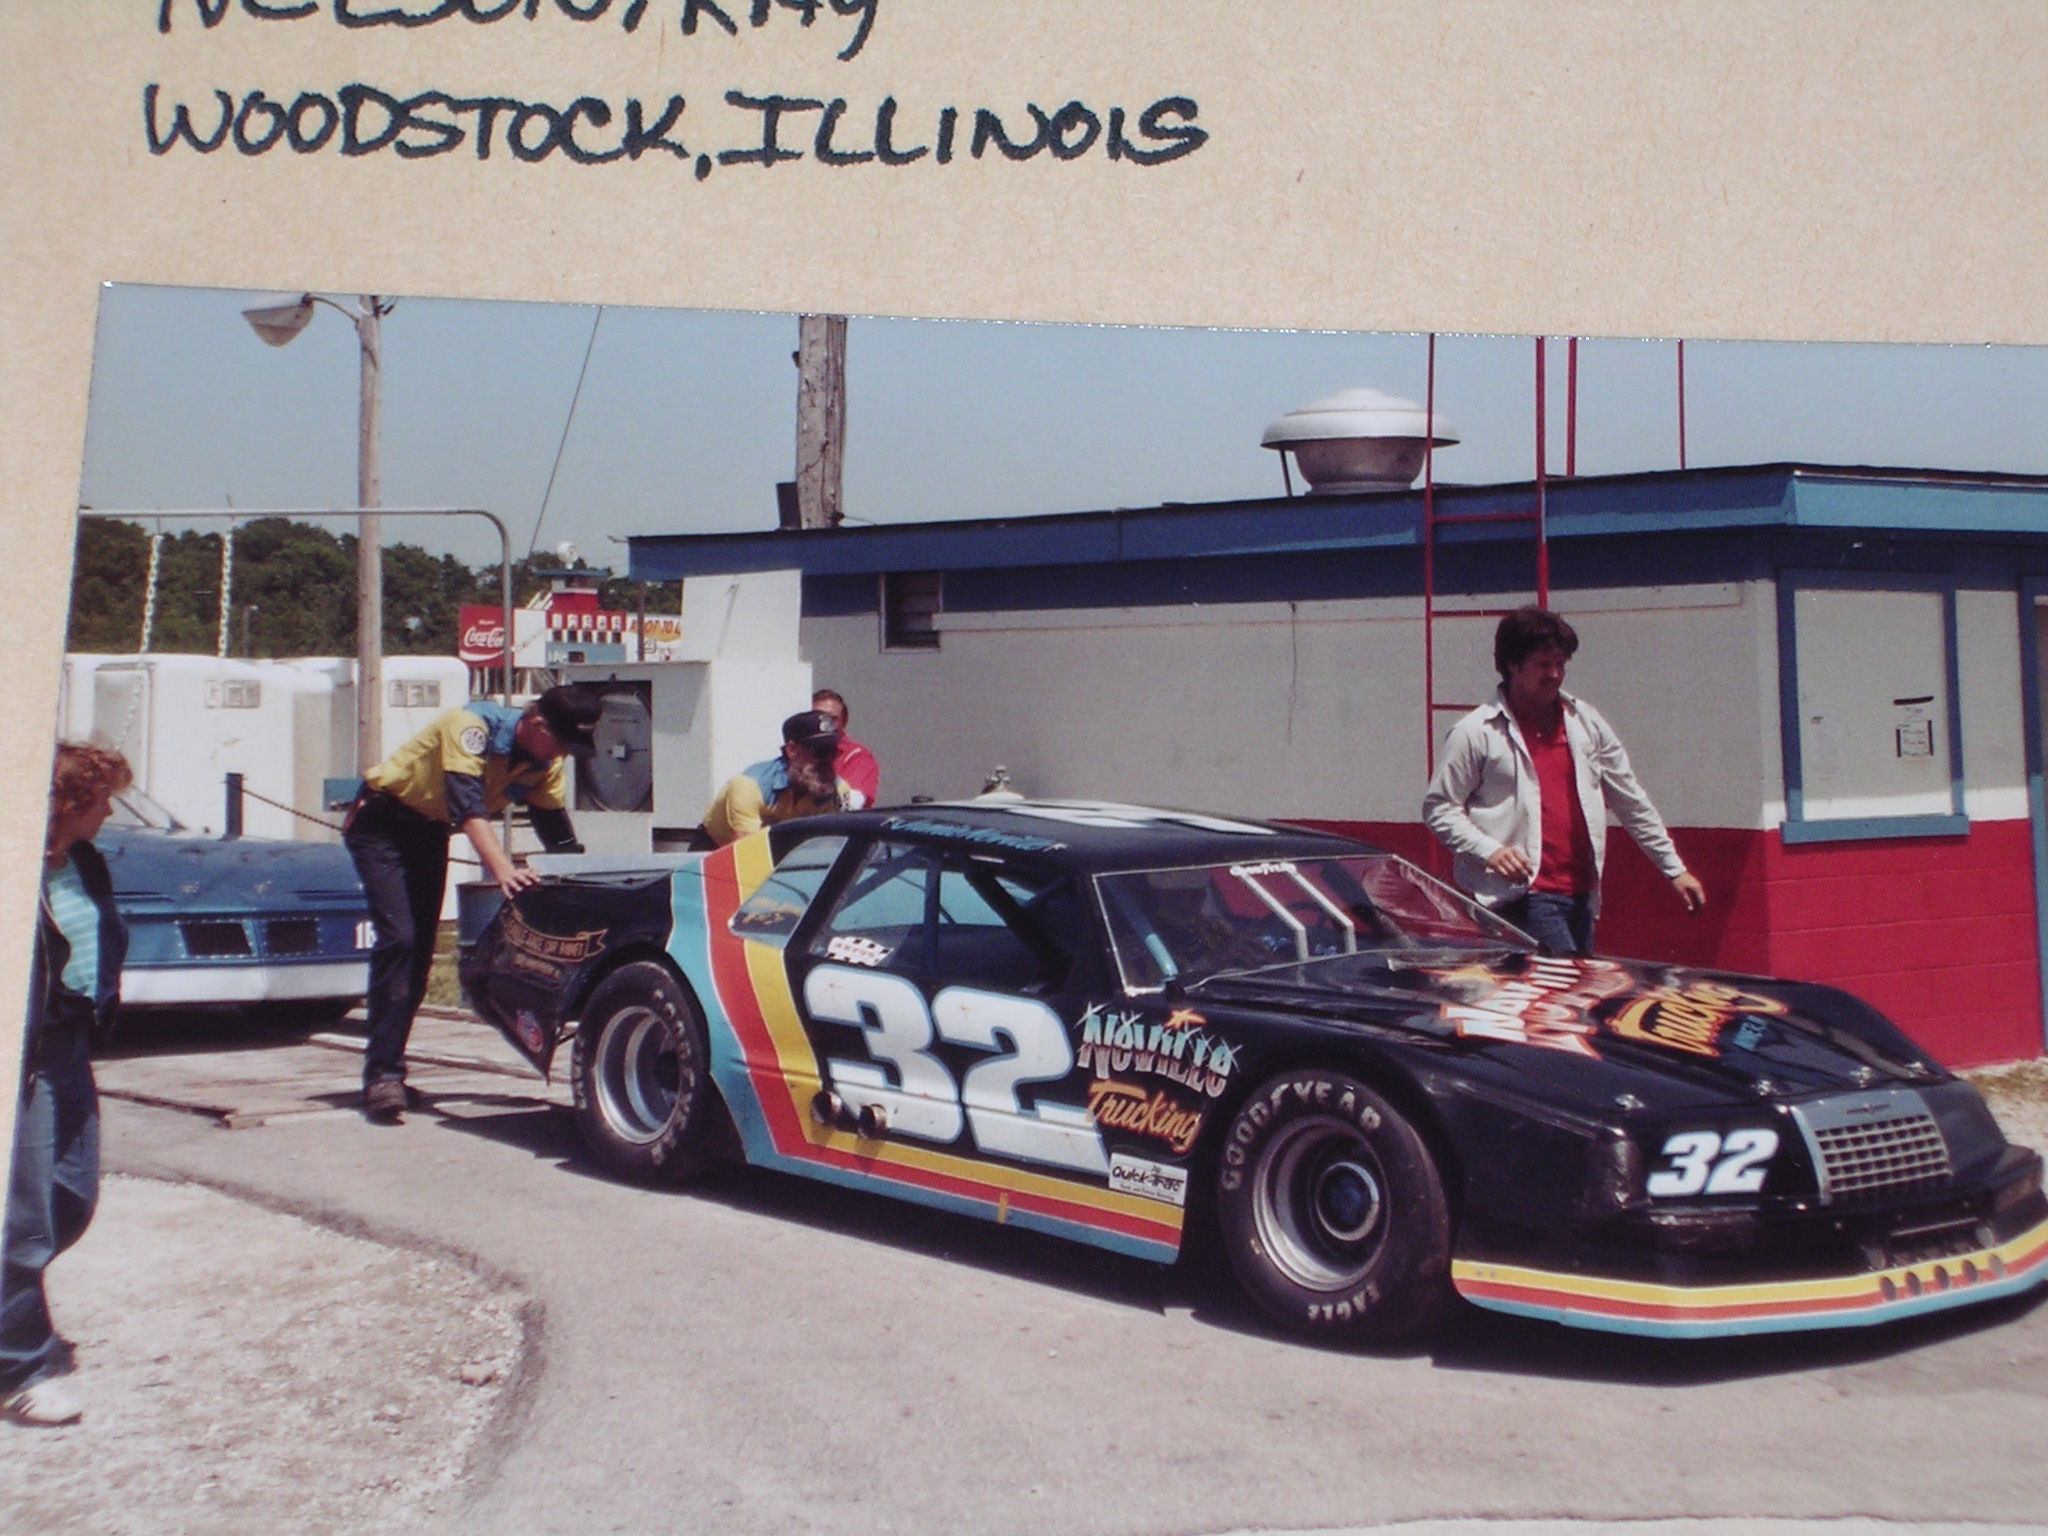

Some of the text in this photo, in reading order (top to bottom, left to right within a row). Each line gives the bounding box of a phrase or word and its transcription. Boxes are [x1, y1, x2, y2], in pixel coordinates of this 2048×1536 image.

[717, 91, 1210, 166] ILLINOIS
[803, 963, 1110, 1178] 32
[1085, 1079, 1202, 1154] Trucking
[1646, 1128, 1779, 1197] 32
